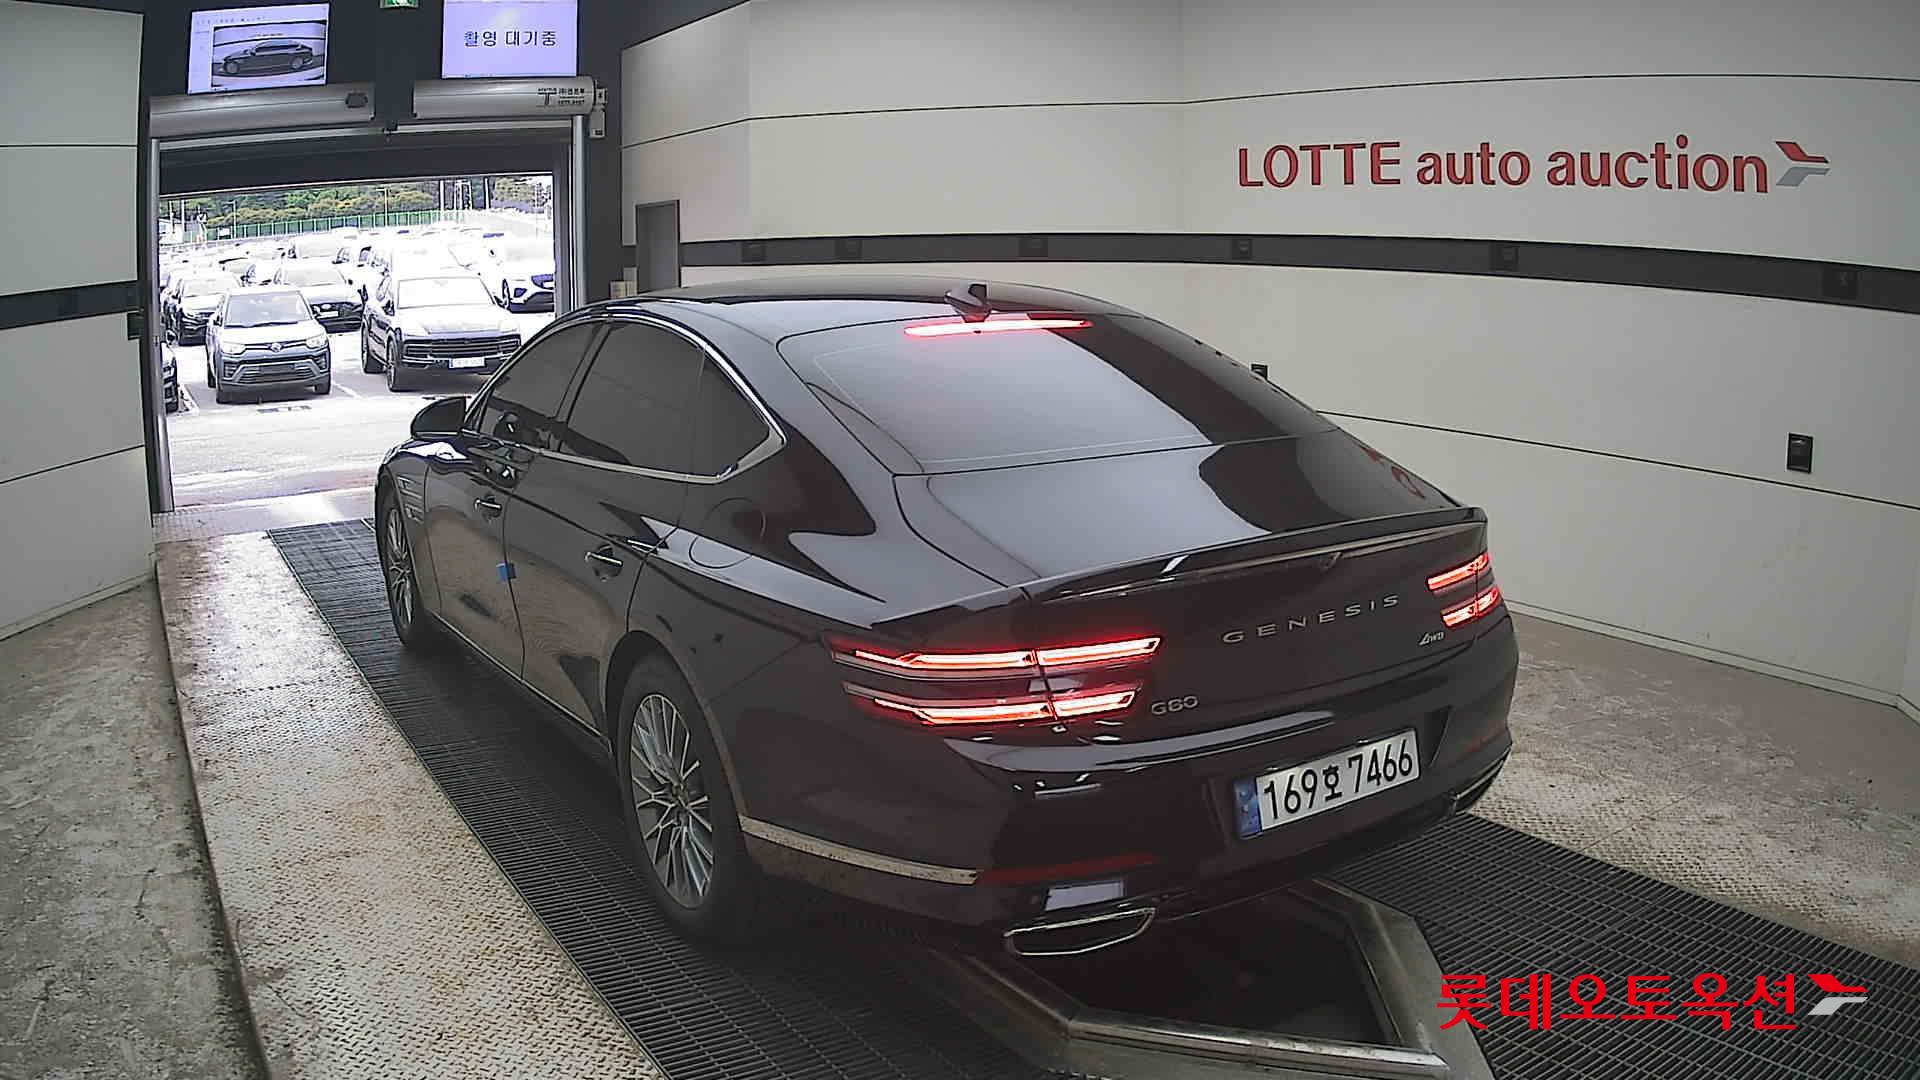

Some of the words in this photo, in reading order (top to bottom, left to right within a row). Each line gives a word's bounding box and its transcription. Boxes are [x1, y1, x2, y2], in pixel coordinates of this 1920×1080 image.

[505, 30, 557, 47] 대기중
[1238, 141, 1400, 188] LOTTE
[1416, 142, 1531, 186] auto
[1546, 134, 1768, 194] auction
[1222, 593, 1400, 644] GENESIS
[1151, 695, 1198, 715] G80
[1263, 764, 1343, 820] 169호
[1348, 739, 1413, 793] 7466
